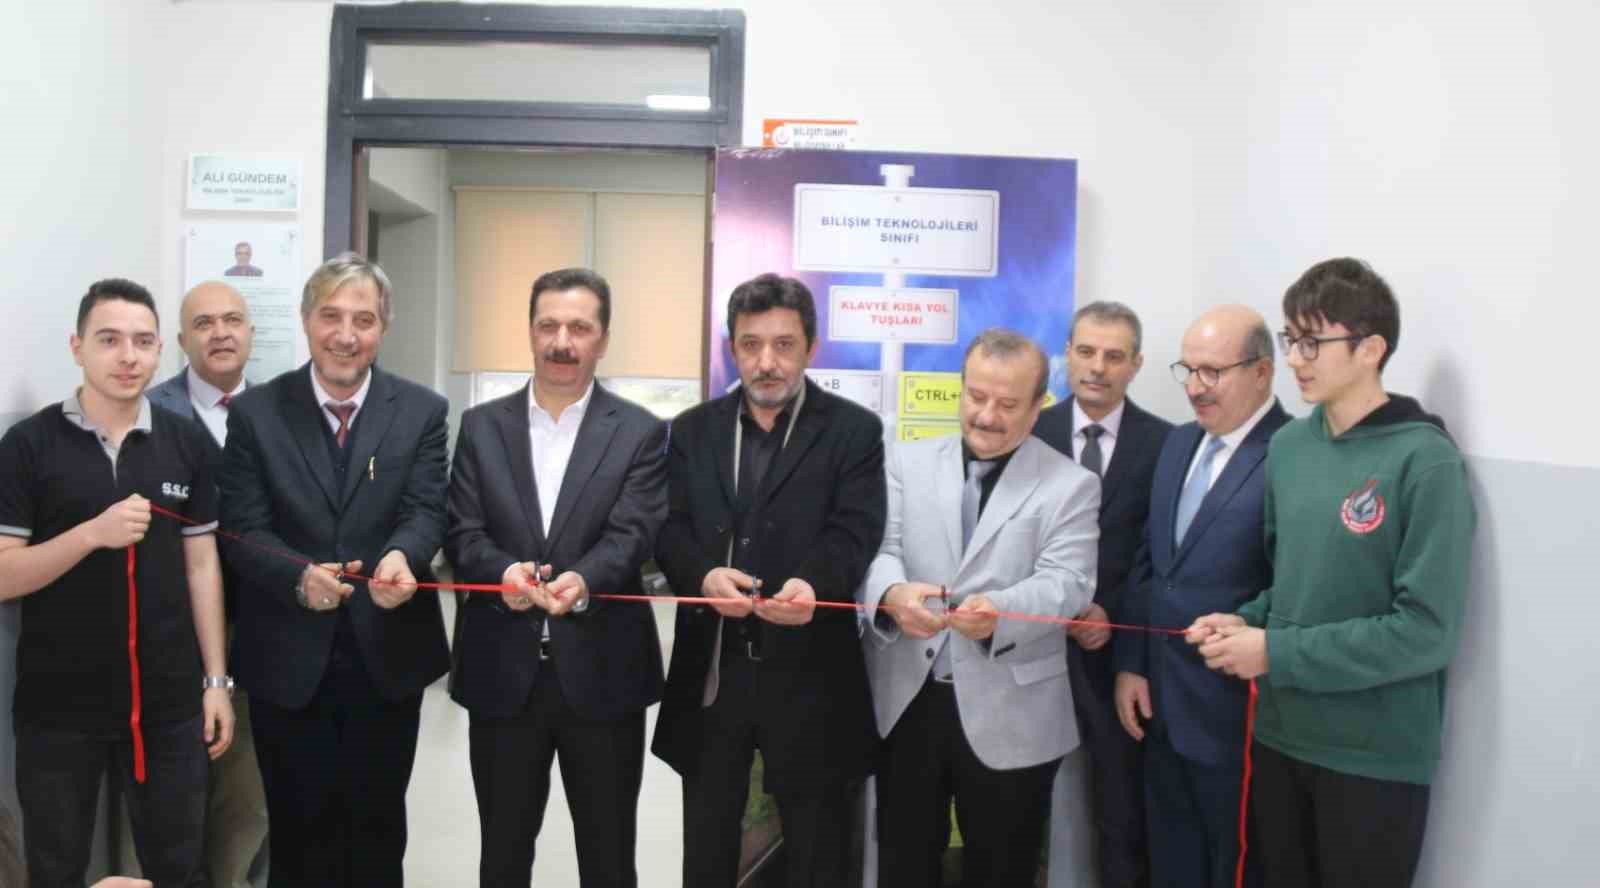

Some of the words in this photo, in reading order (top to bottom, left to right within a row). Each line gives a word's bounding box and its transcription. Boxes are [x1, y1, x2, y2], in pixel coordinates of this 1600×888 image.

[821, 215, 870, 228] BİLİŞİM
[876, 217, 978, 231] TEKNOLOJİLERİ
[880, 233, 919, 243] SINIFI
[841, 301, 888, 311] KLAVYE
[893, 302, 921, 312] KISA
[927, 303, 948, 313] YOL
[871, 314, 923, 327] TUŞLARI
